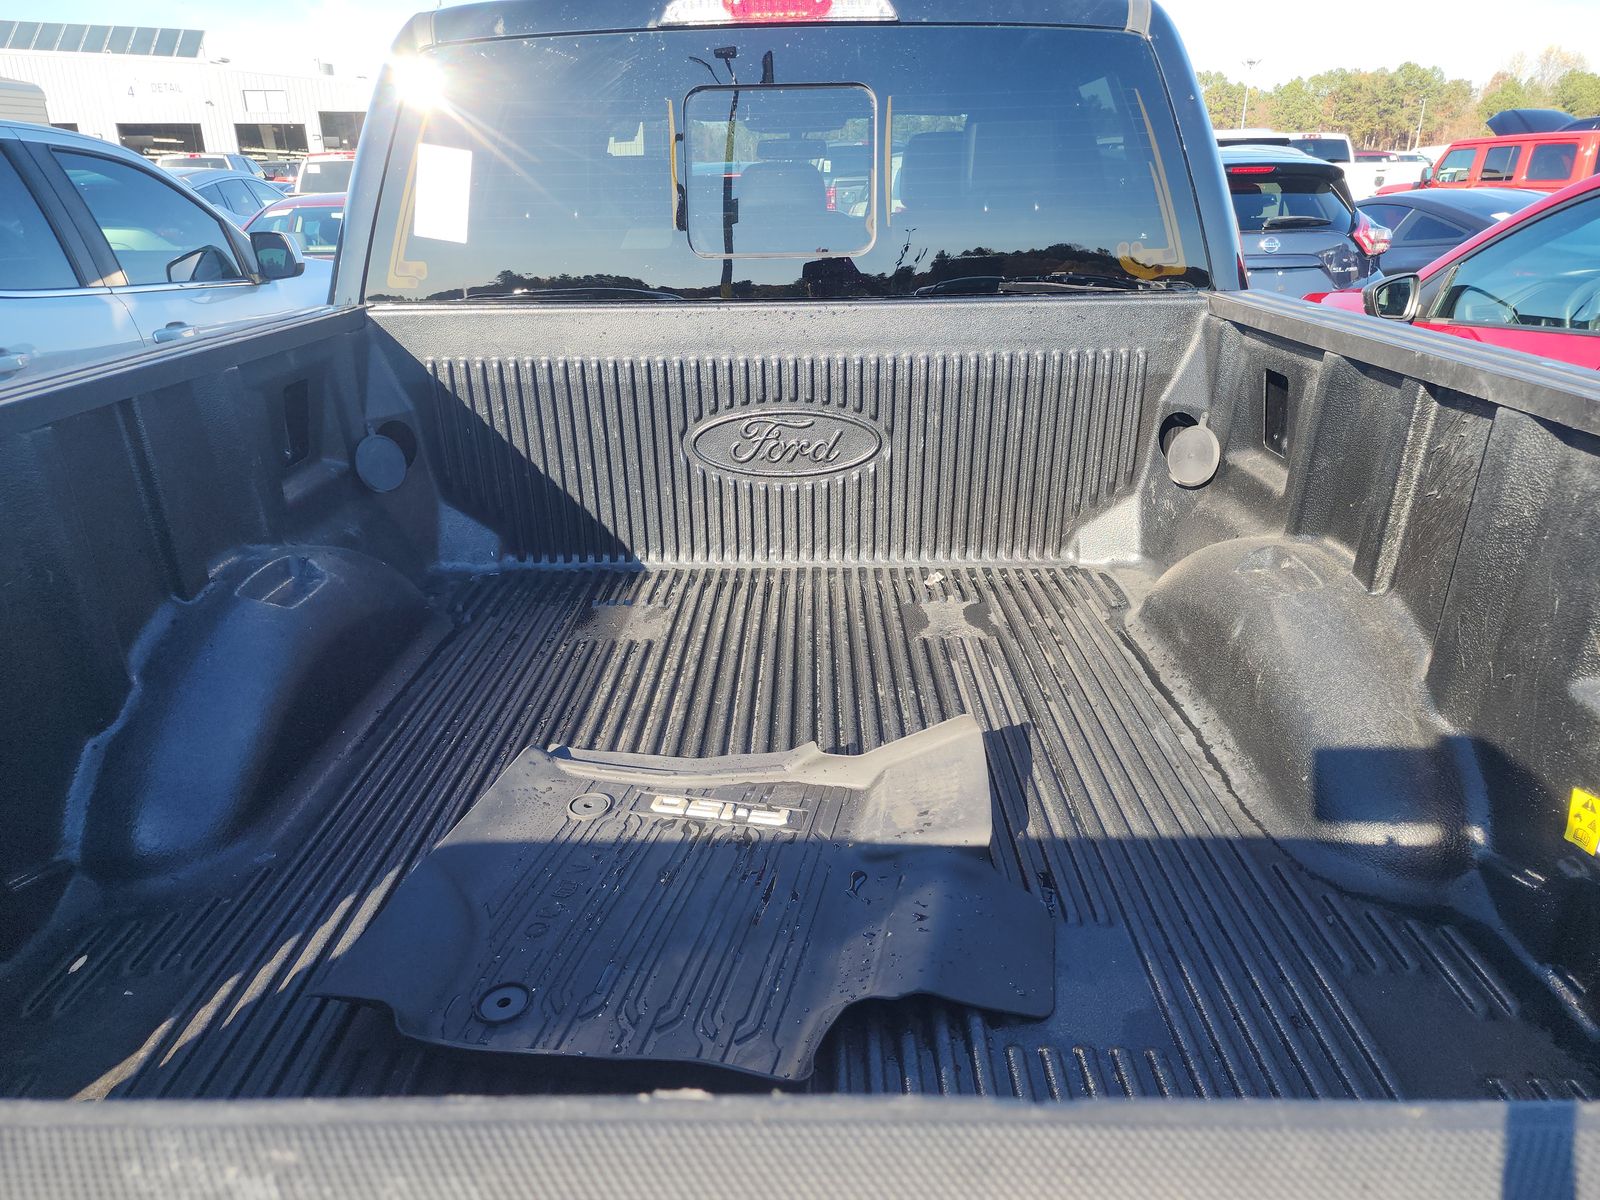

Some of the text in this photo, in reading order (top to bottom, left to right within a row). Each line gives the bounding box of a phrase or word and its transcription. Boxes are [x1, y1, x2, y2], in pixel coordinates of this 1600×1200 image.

[127, 85, 136, 98] 4
[150, 82, 184, 94] DETAIL
[730, 416, 845, 464] Ford
